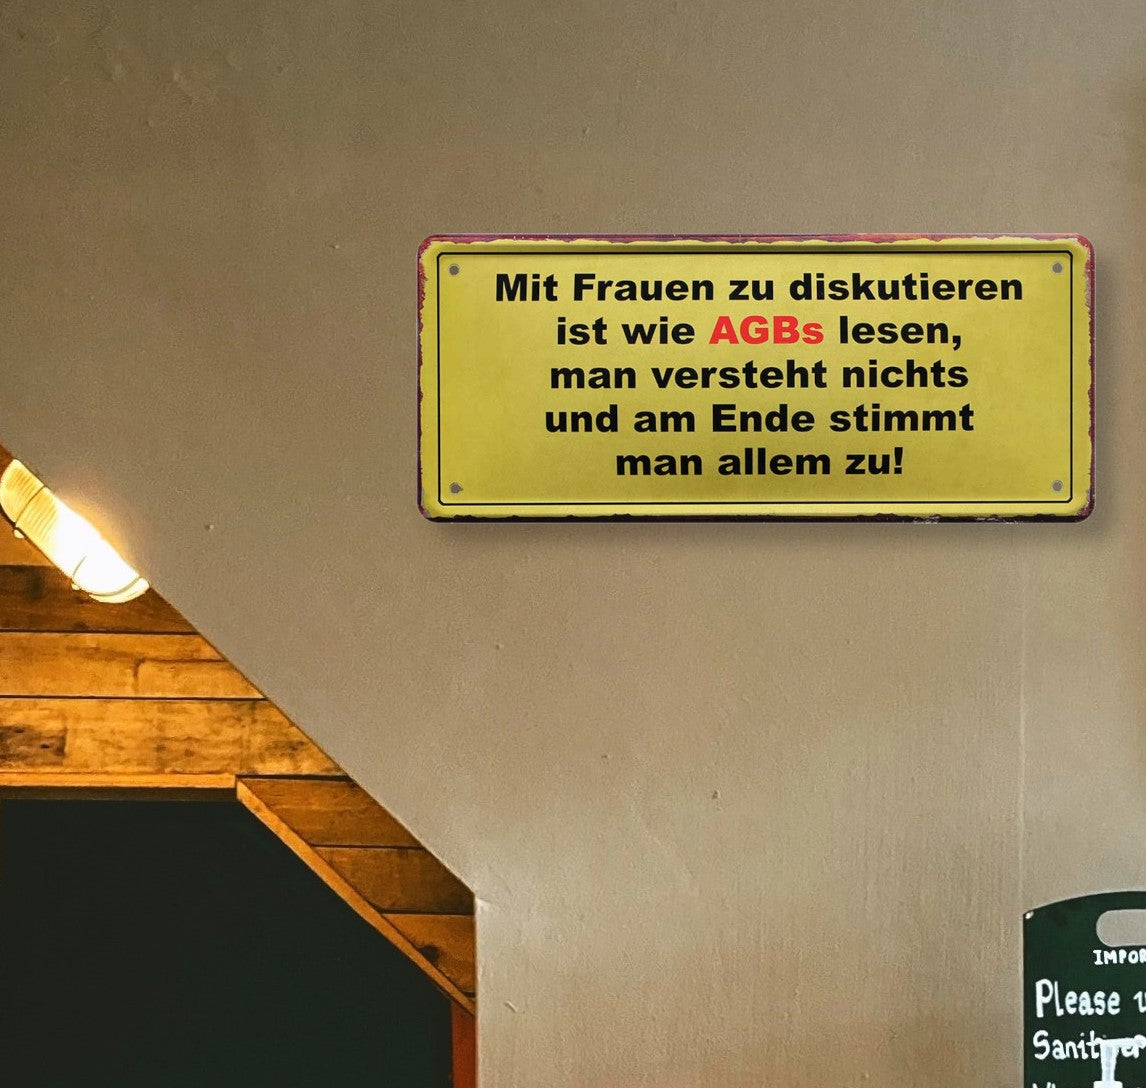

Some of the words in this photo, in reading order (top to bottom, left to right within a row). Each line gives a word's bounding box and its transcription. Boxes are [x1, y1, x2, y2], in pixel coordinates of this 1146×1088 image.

[495, 273, 558, 302] Mit
[573, 273, 714, 302] Frauen
[728, 280, 774, 301] zu
[789, 272, 1023, 301] diskutieren
[557, 316, 608, 346] ist
[621, 316, 695, 345] wie
[709, 315, 824, 345] AGBs
[839, 315, 962, 350] lesen,
[550, 367, 636, 389] man
[650, 359, 828, 389] versteht
[842, 359, 969, 388] nichts
[545, 403, 619, 433] und
[633, 411, 696, 433] am
[712, 403, 815, 433] Ende
[829, 403, 975, 433] stimmt
[616, 454, 703, 476] man
[717, 447, 831, 476] allem
[845, 446, 904, 475] zu!
[1035, 978, 1121, 1018] Please
[1032, 1029, 1145, 1060] Saniter
